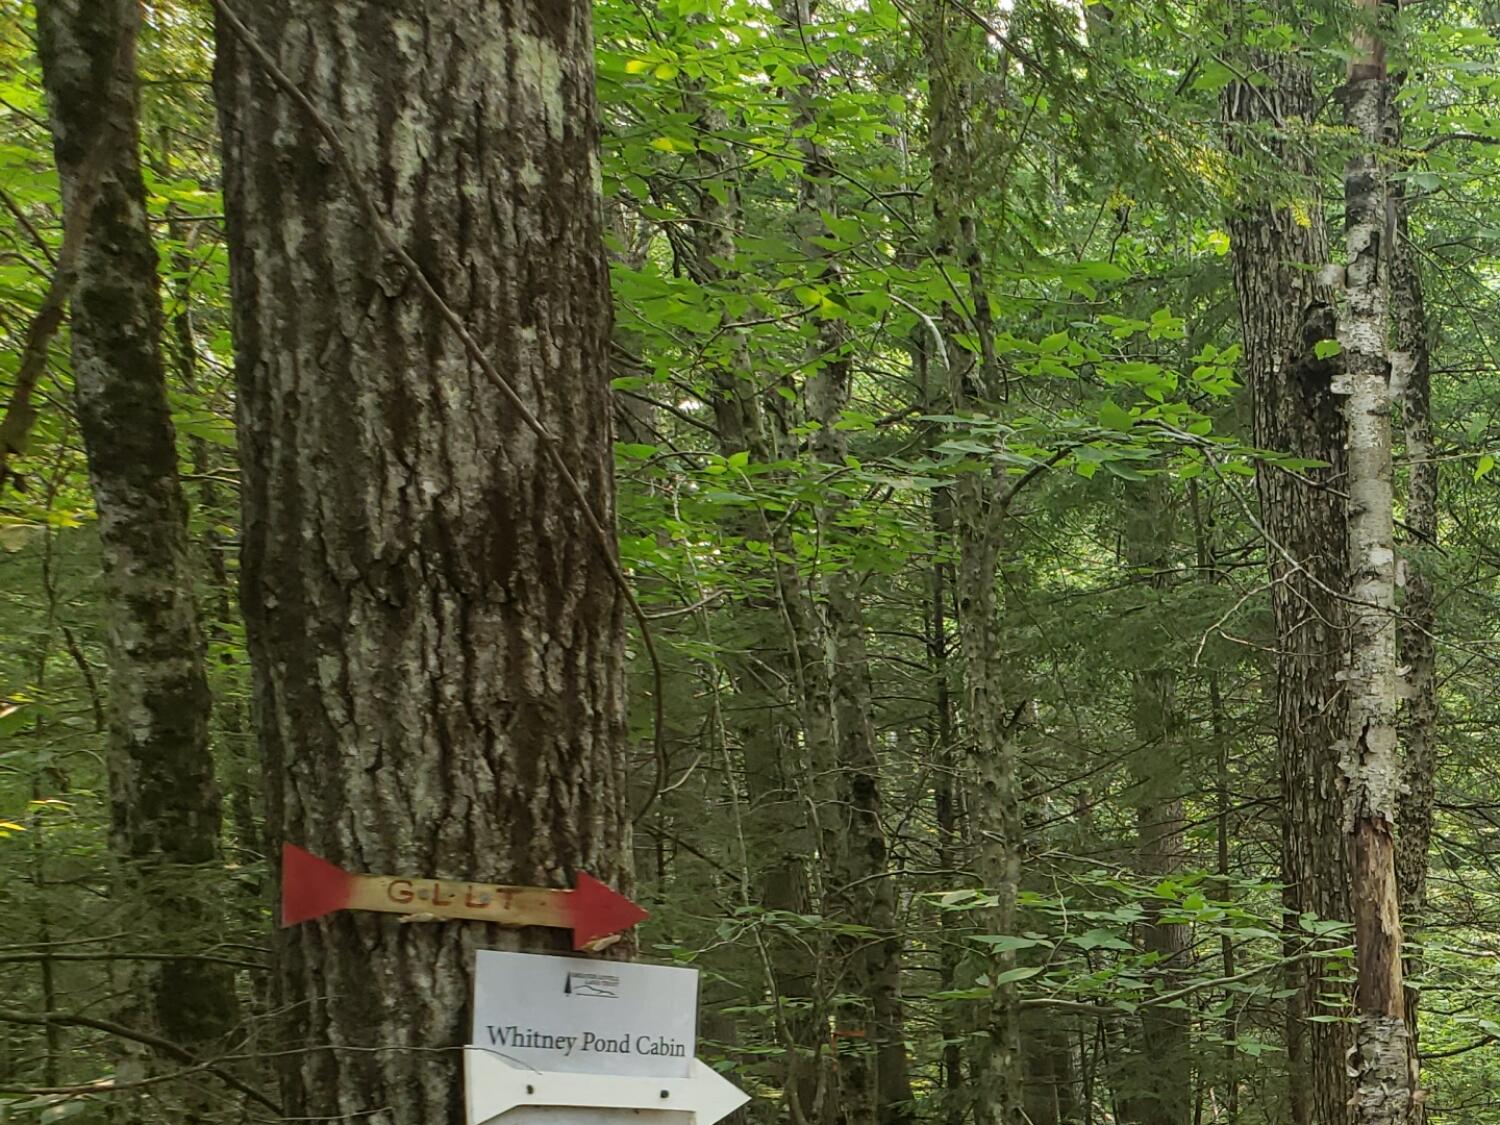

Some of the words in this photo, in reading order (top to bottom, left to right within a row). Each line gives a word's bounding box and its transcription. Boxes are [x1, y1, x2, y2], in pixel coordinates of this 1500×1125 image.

[486, 1025, 577, 1056] Whitney
[581, 1032, 631, 1054] Pond
[636, 1035, 686, 1057] Cabin
